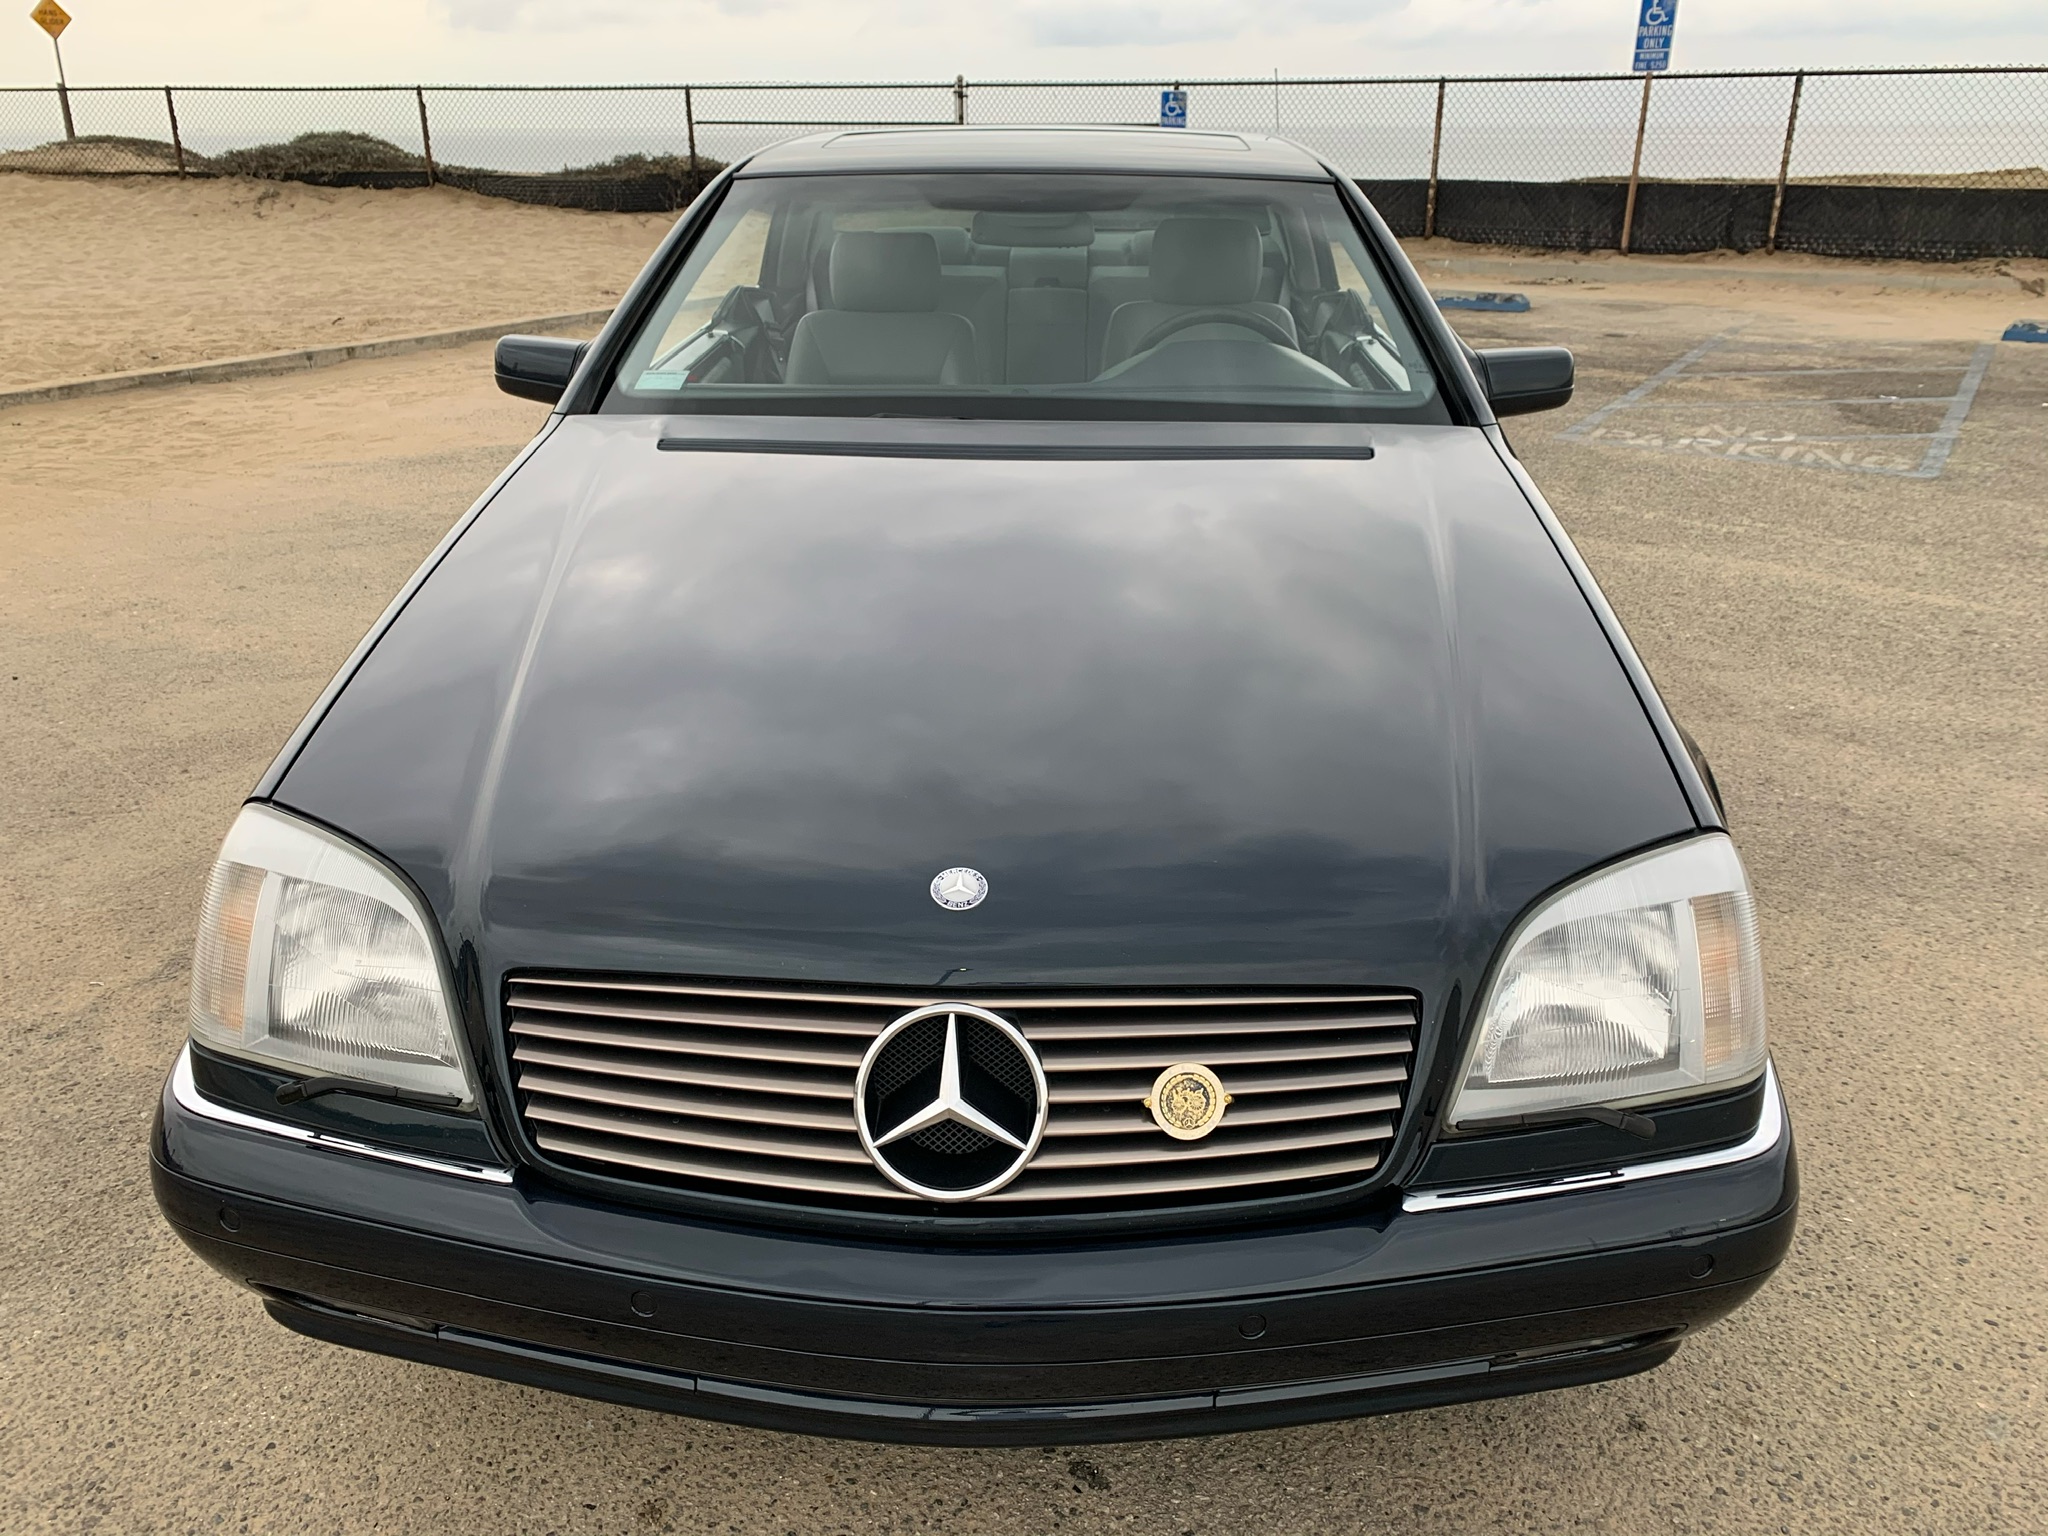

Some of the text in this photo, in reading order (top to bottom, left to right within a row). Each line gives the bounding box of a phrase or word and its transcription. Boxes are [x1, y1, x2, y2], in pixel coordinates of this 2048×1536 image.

[1639, 25, 1673, 37] PARKING
[1643, 37, 1665, 49] ONLY
[1639, 52, 1665, 60] MINIMUM
[1634, 60, 1667, 70] FINE $250
